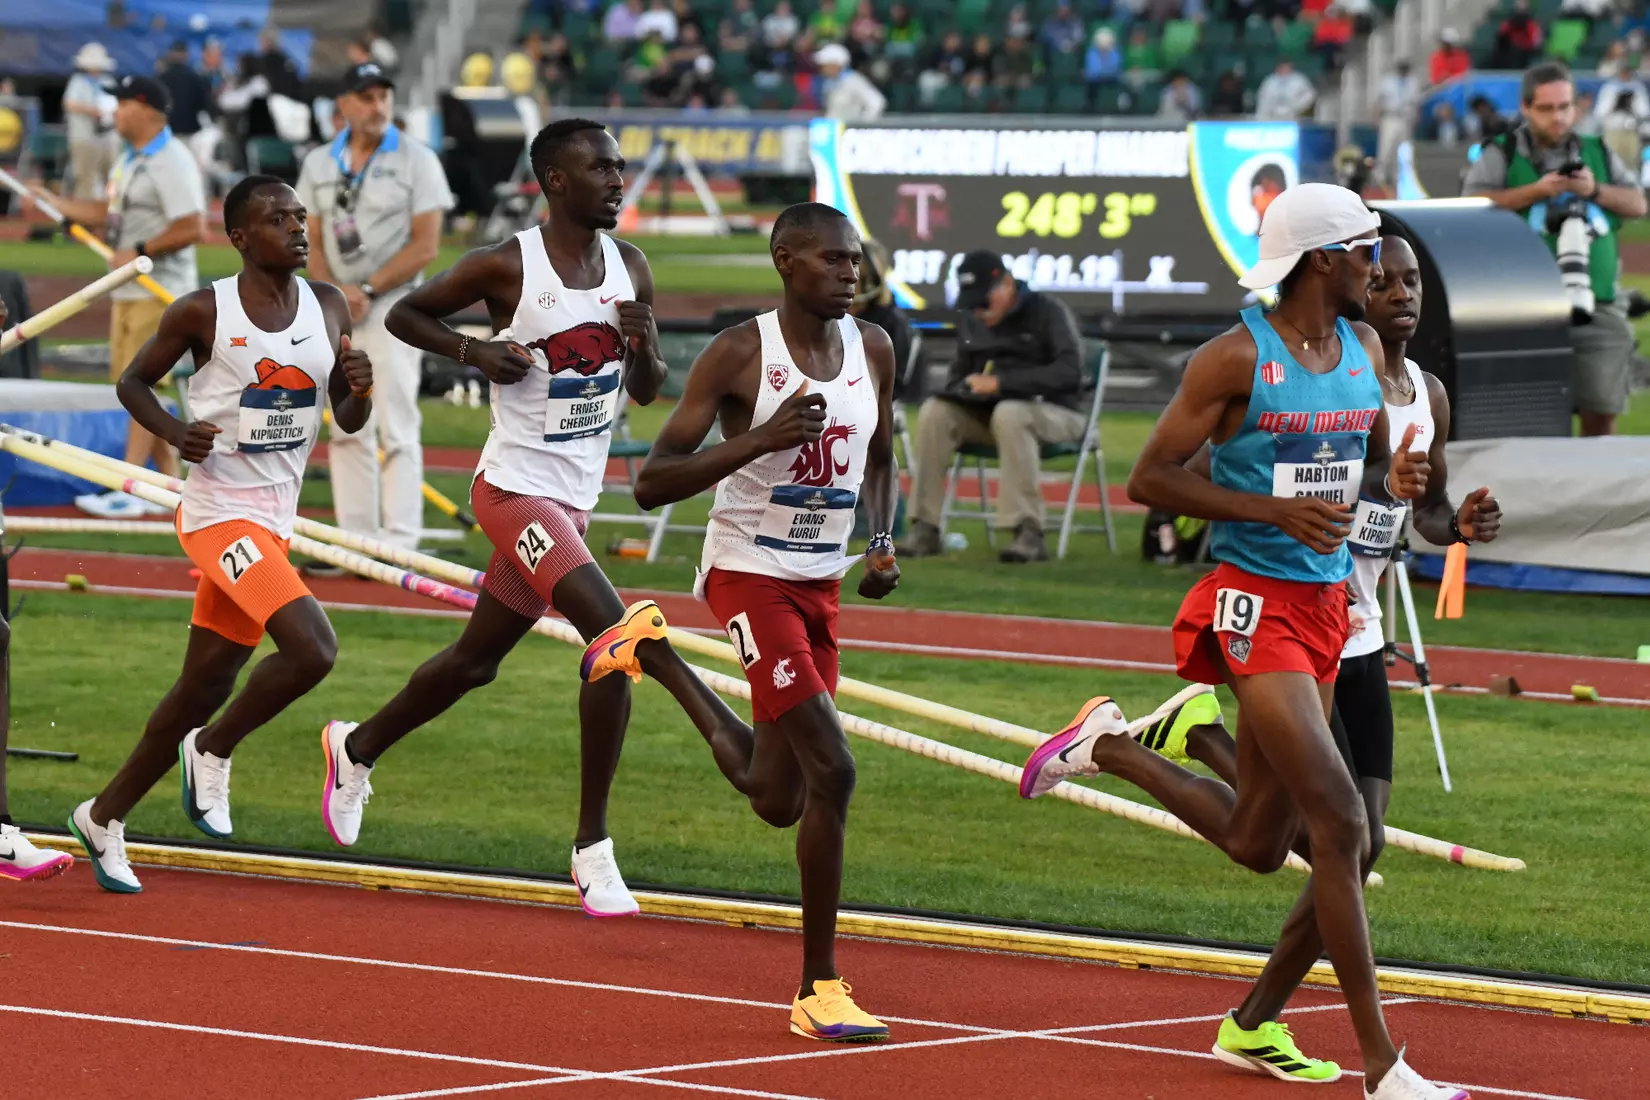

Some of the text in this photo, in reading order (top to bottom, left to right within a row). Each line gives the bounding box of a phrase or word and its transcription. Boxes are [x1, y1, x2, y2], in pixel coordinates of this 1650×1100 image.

[772, 375, 784, 387] 12
[570, 400, 605, 415] ERNEST
[267, 414, 294, 426] DENIS
[560, 411, 607, 430] CHERUIYOT
[250, 427, 304, 440] KIPNGETICH
[1294, 465, 1349, 483] HABTOM
[792, 513, 826, 525] EVANS
[788, 527, 820, 539] KURUI
[518, 527, 547, 568] 24
[222, 542, 254, 580] 21
[1218, 590, 1254, 631] 19
[730, 620, 754, 666] 2
